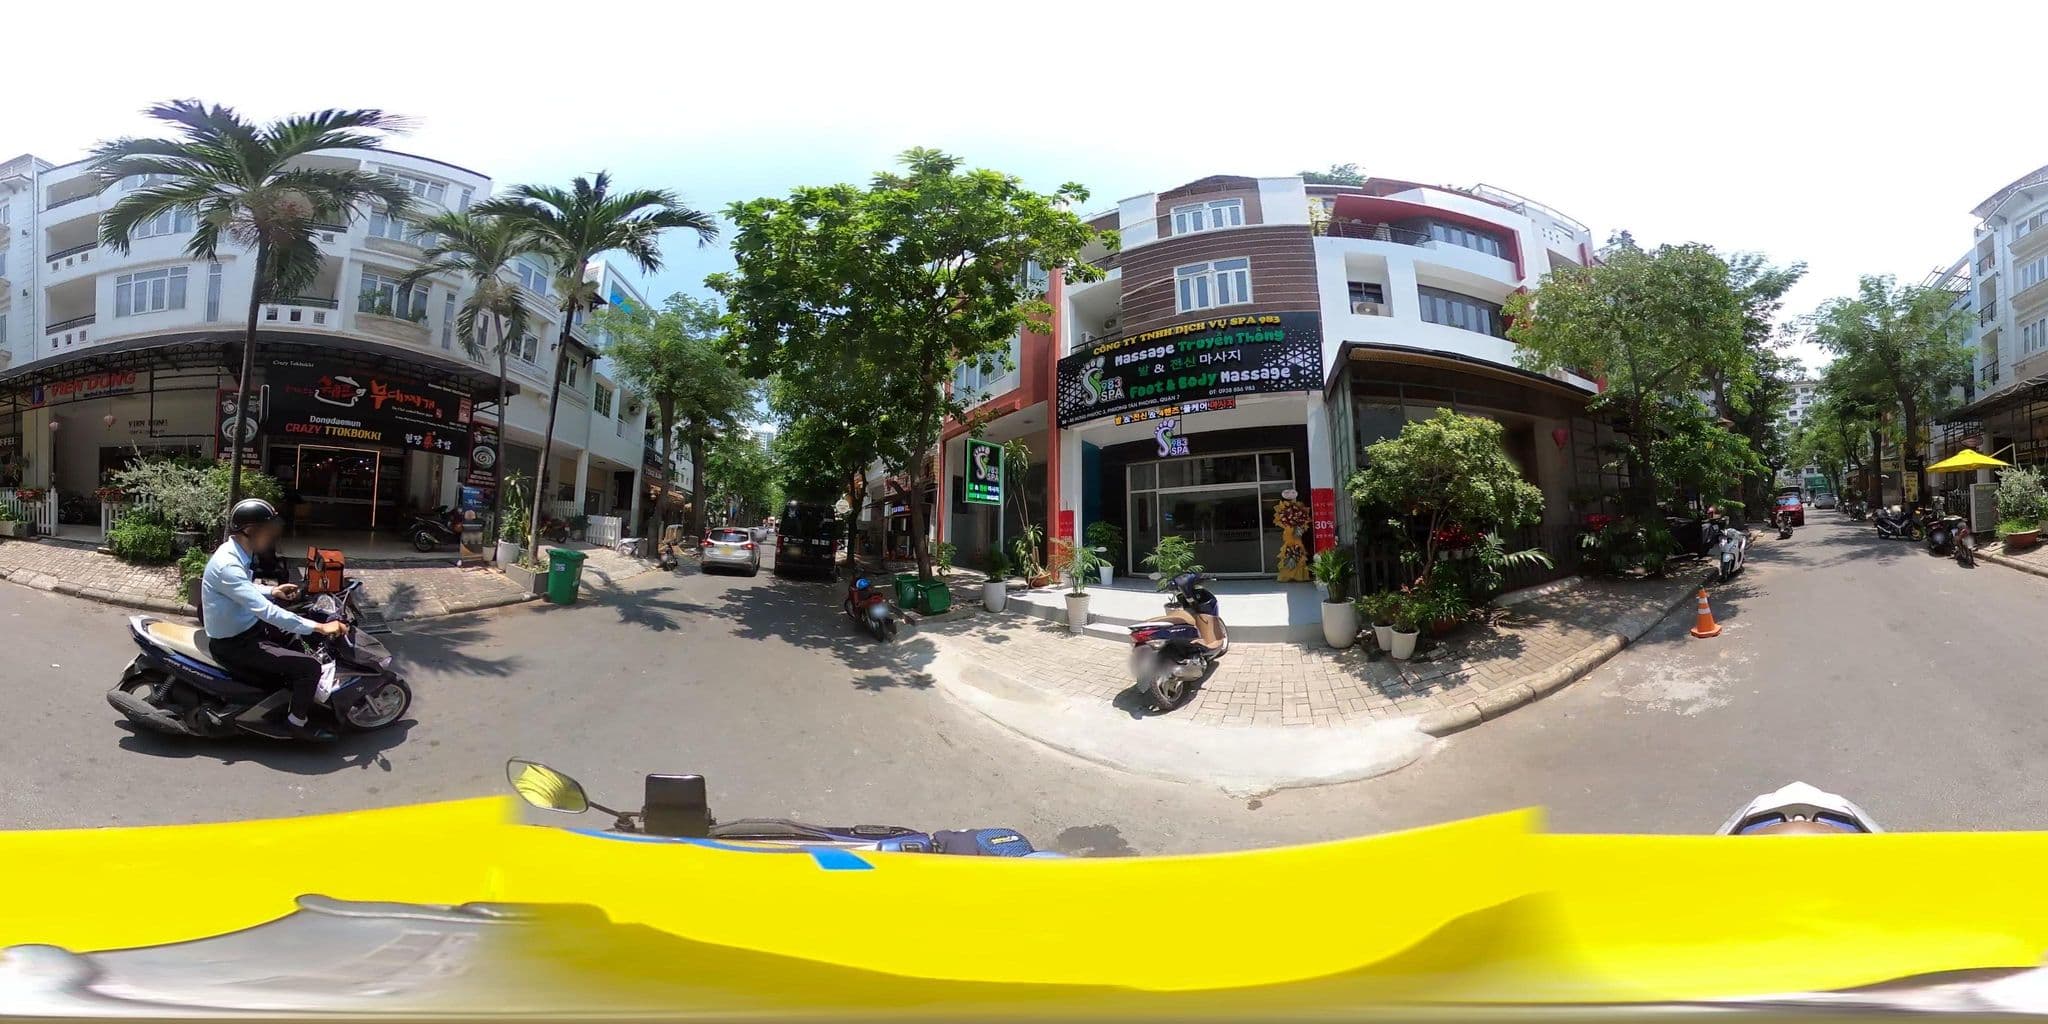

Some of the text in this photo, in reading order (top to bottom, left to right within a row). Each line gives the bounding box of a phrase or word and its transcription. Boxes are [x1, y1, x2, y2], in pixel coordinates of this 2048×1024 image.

[1123, 336, 1138, 346] TY
[1140, 328, 1171, 342] TNHH
[1174, 322, 1206, 335] DỊCH
[1208, 318, 1228, 329] VỤ
[1230, 316, 1257, 326] SPA
[1258, 315, 1281, 324] 983
[1114, 344, 1175, 367] Massage
[1153, 363, 1165, 374] &
[1199, 349, 1241, 365] 마사지
[1100, 377, 1121, 392] 983
[1129, 380, 1164, 399] Foot
[1178, 372, 1218, 390] Body
[1220, 366, 1291, 384] Massage
[1100, 387, 1124, 402] SPA
[309, 415, 362, 428] Dongdaemun
[285, 423, 382, 441] CRAZY TTOKBOKKI
[1171, 439, 1188, 447] 983
[1171, 446, 1189, 456] SPA
[1315, 521, 1334, 530] 30%
